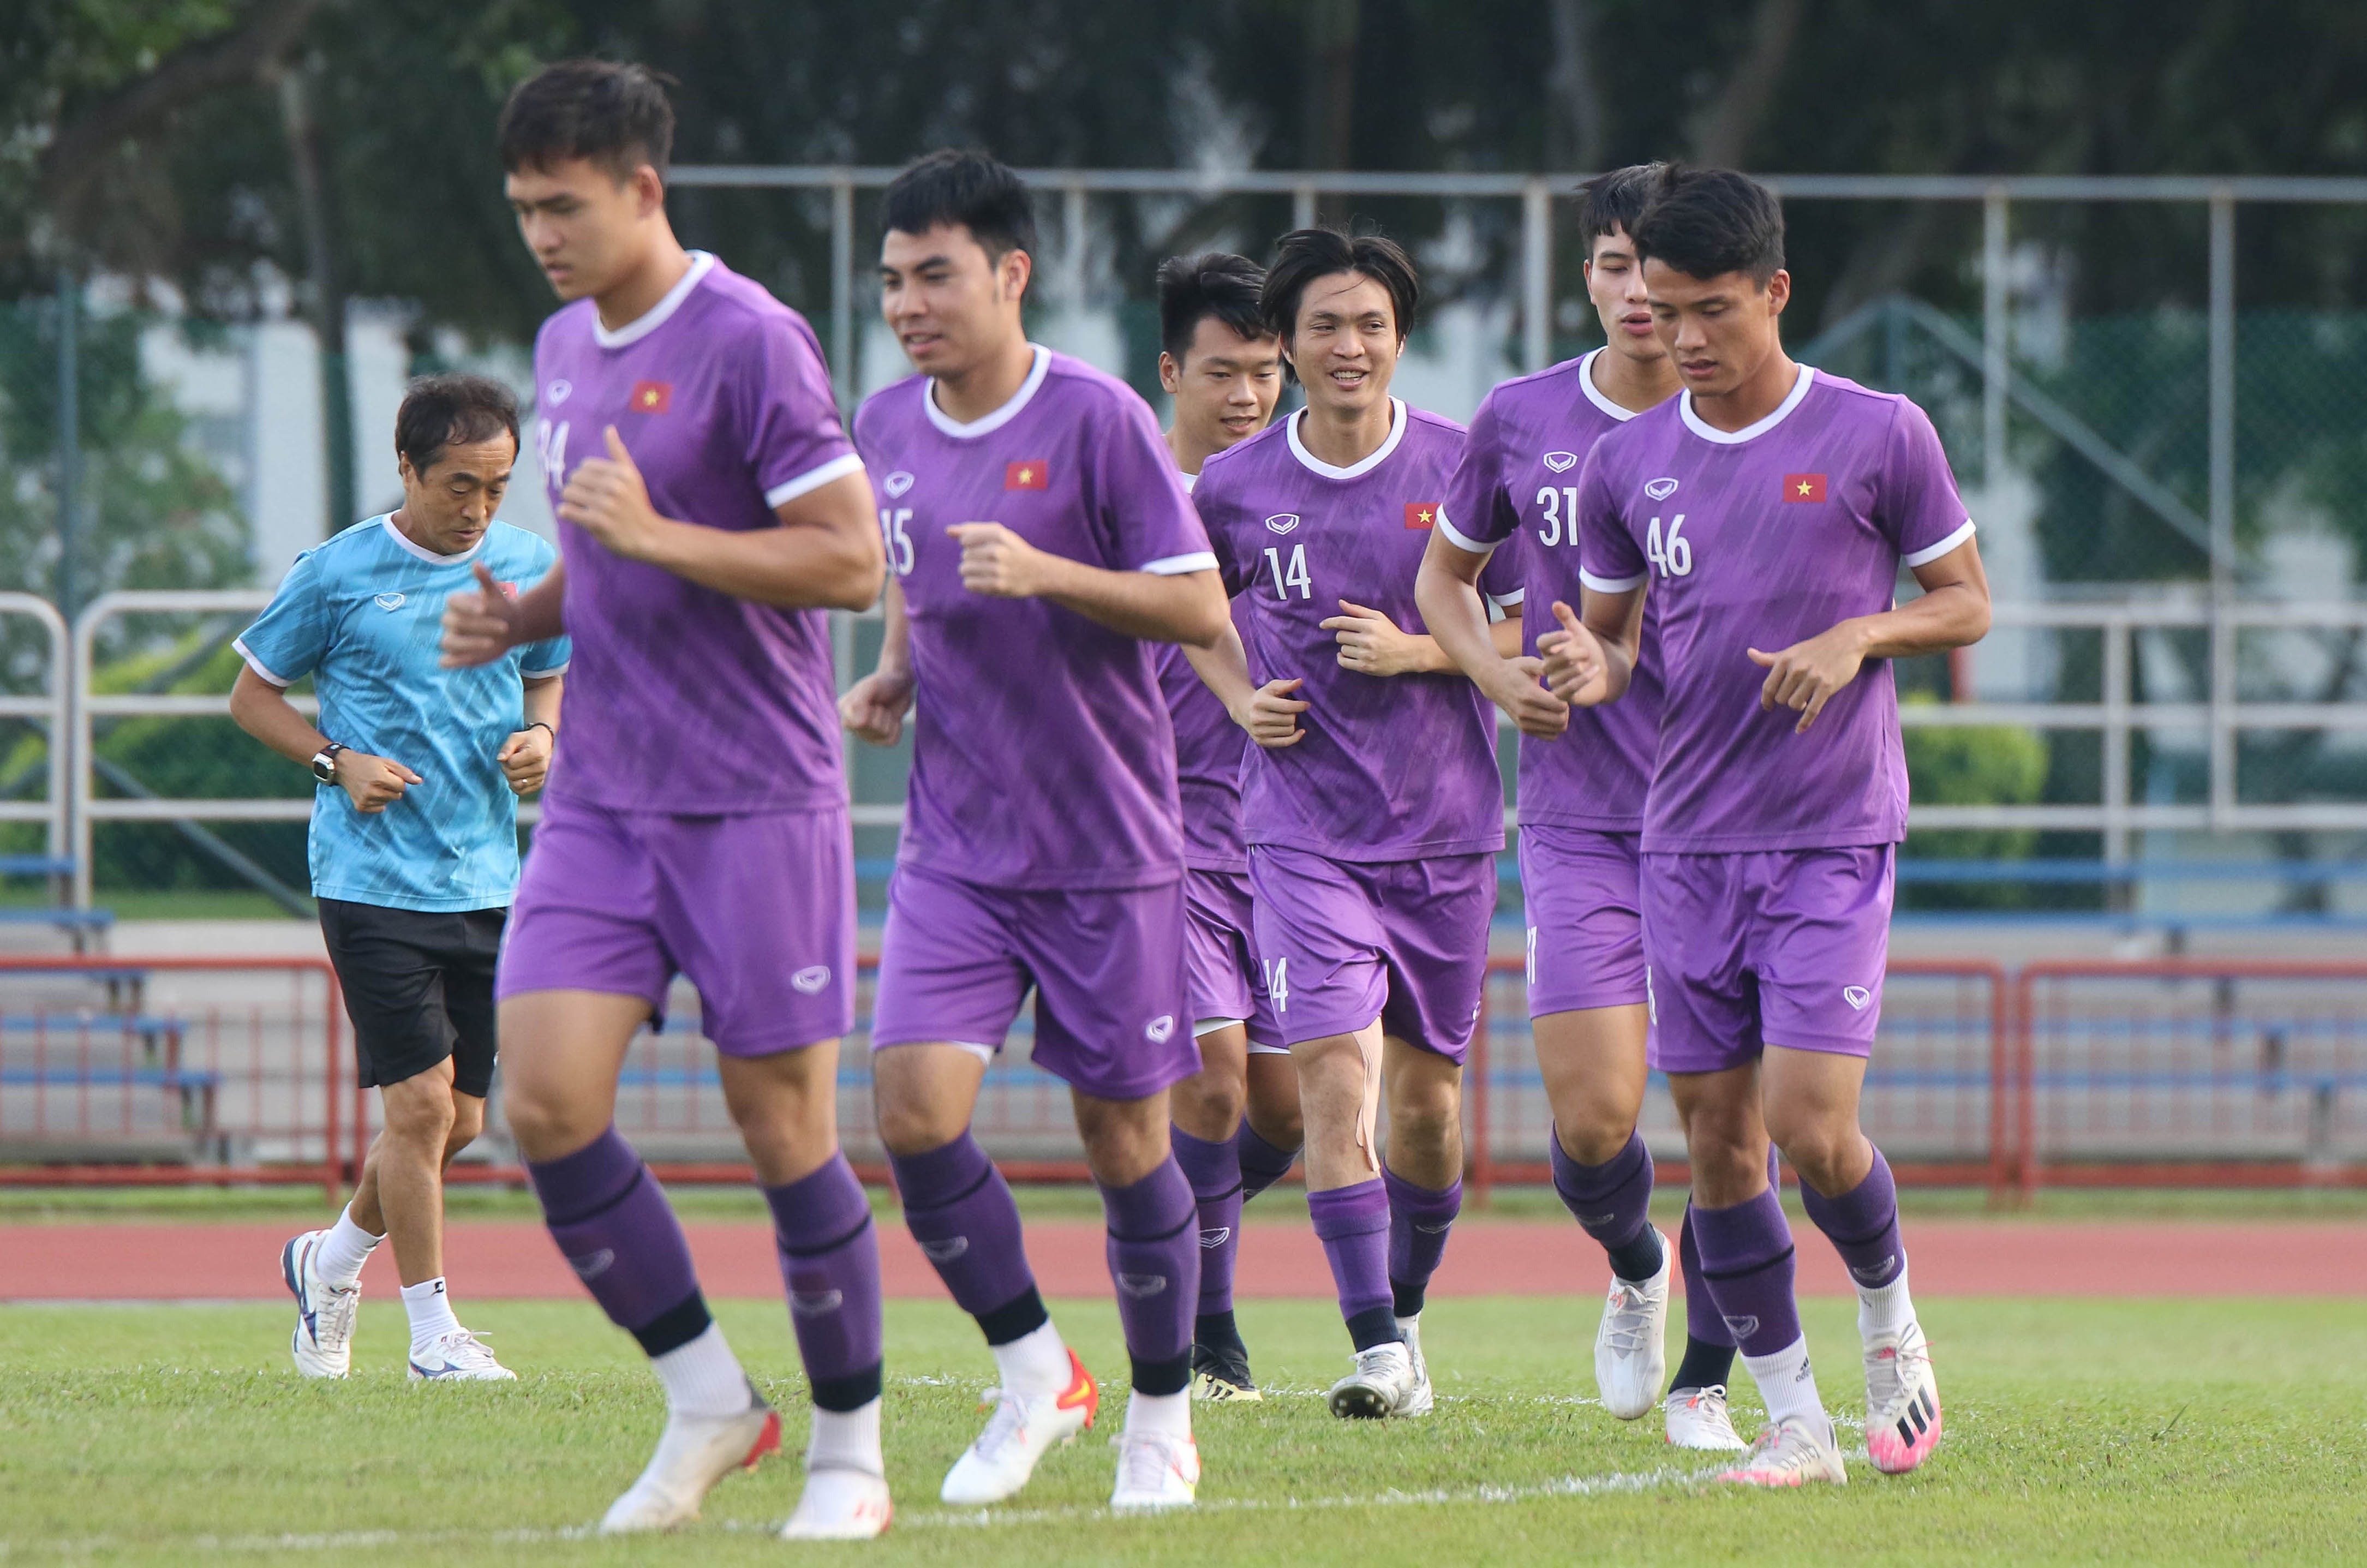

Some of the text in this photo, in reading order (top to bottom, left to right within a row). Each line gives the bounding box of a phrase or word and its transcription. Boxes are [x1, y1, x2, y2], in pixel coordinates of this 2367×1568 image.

[1537, 487, 1578, 547] 31
[1647, 514, 1692, 577] 46
[1264, 544, 1311, 600] 14
